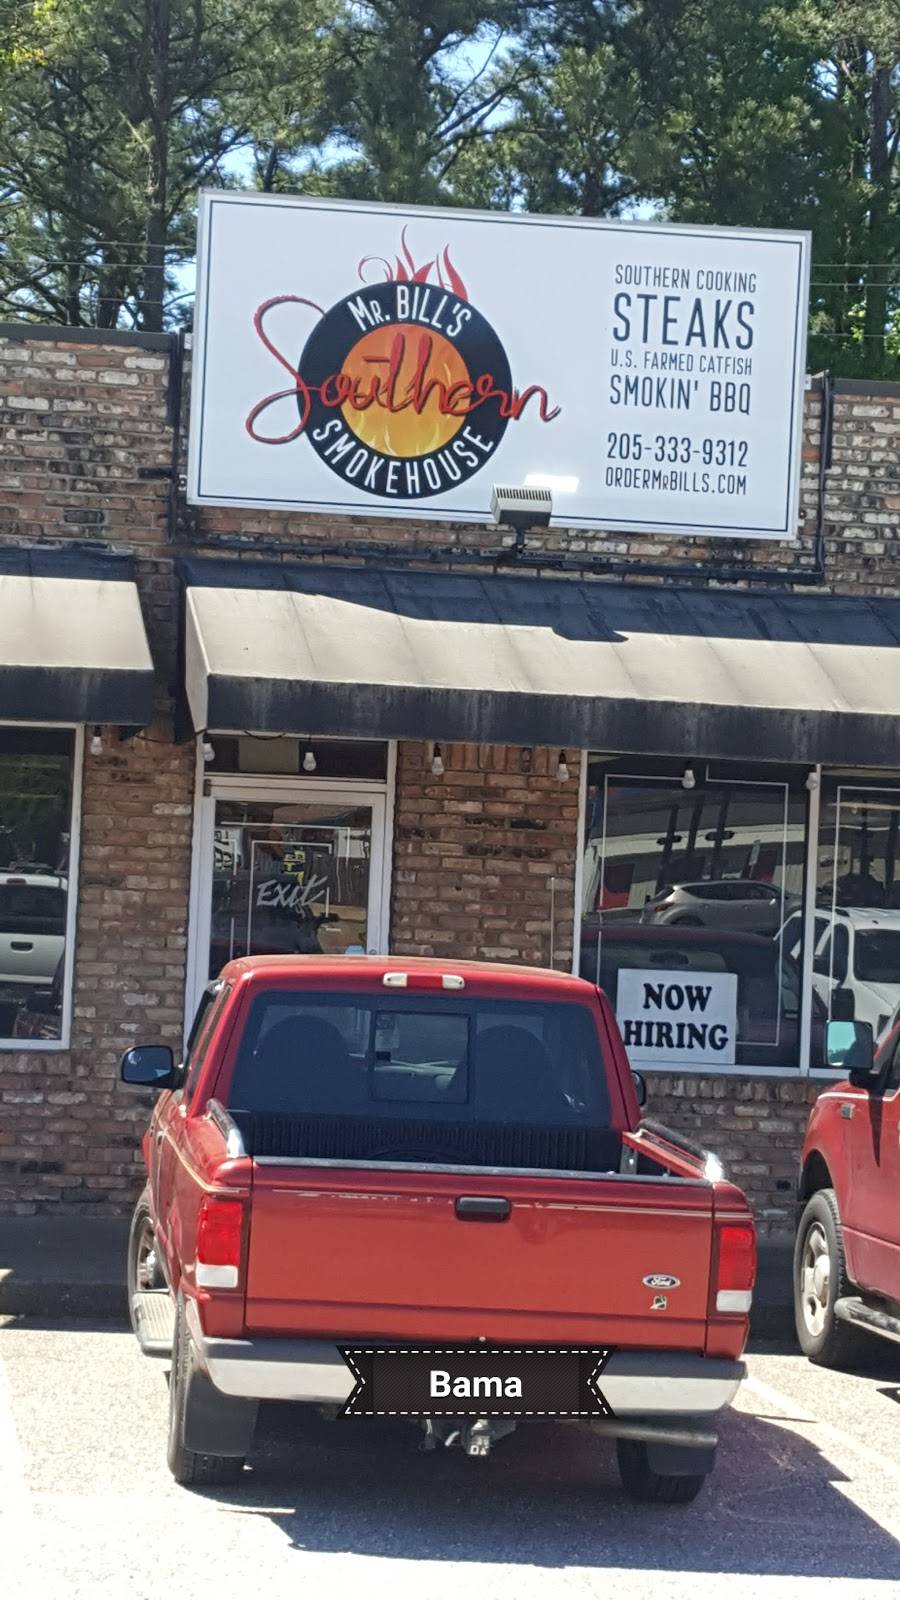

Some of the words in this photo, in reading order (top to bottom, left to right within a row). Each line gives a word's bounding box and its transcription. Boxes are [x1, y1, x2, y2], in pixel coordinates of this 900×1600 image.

[614, 264, 690, 290] SOUTHERN
[696, 270, 757, 293] COOKING
[396, 285, 472, 337] BILL'S
[612, 292, 755, 350] STEAKS
[246, 294, 561, 445] Southern
[610, 349, 638, 369] U.S.
[643, 351, 694, 372] FARMED
[699, 355, 753, 376] CATFISH
[609, 374, 699, 410] SMOKIN'
[709, 380, 751, 416] BBQ
[312, 418, 494, 495] SMOKEHOUSE
[607, 432, 749, 467] 205-333-9312
[642, 982, 713, 1012] NOW
[623, 1019, 729, 1051] HIRING
